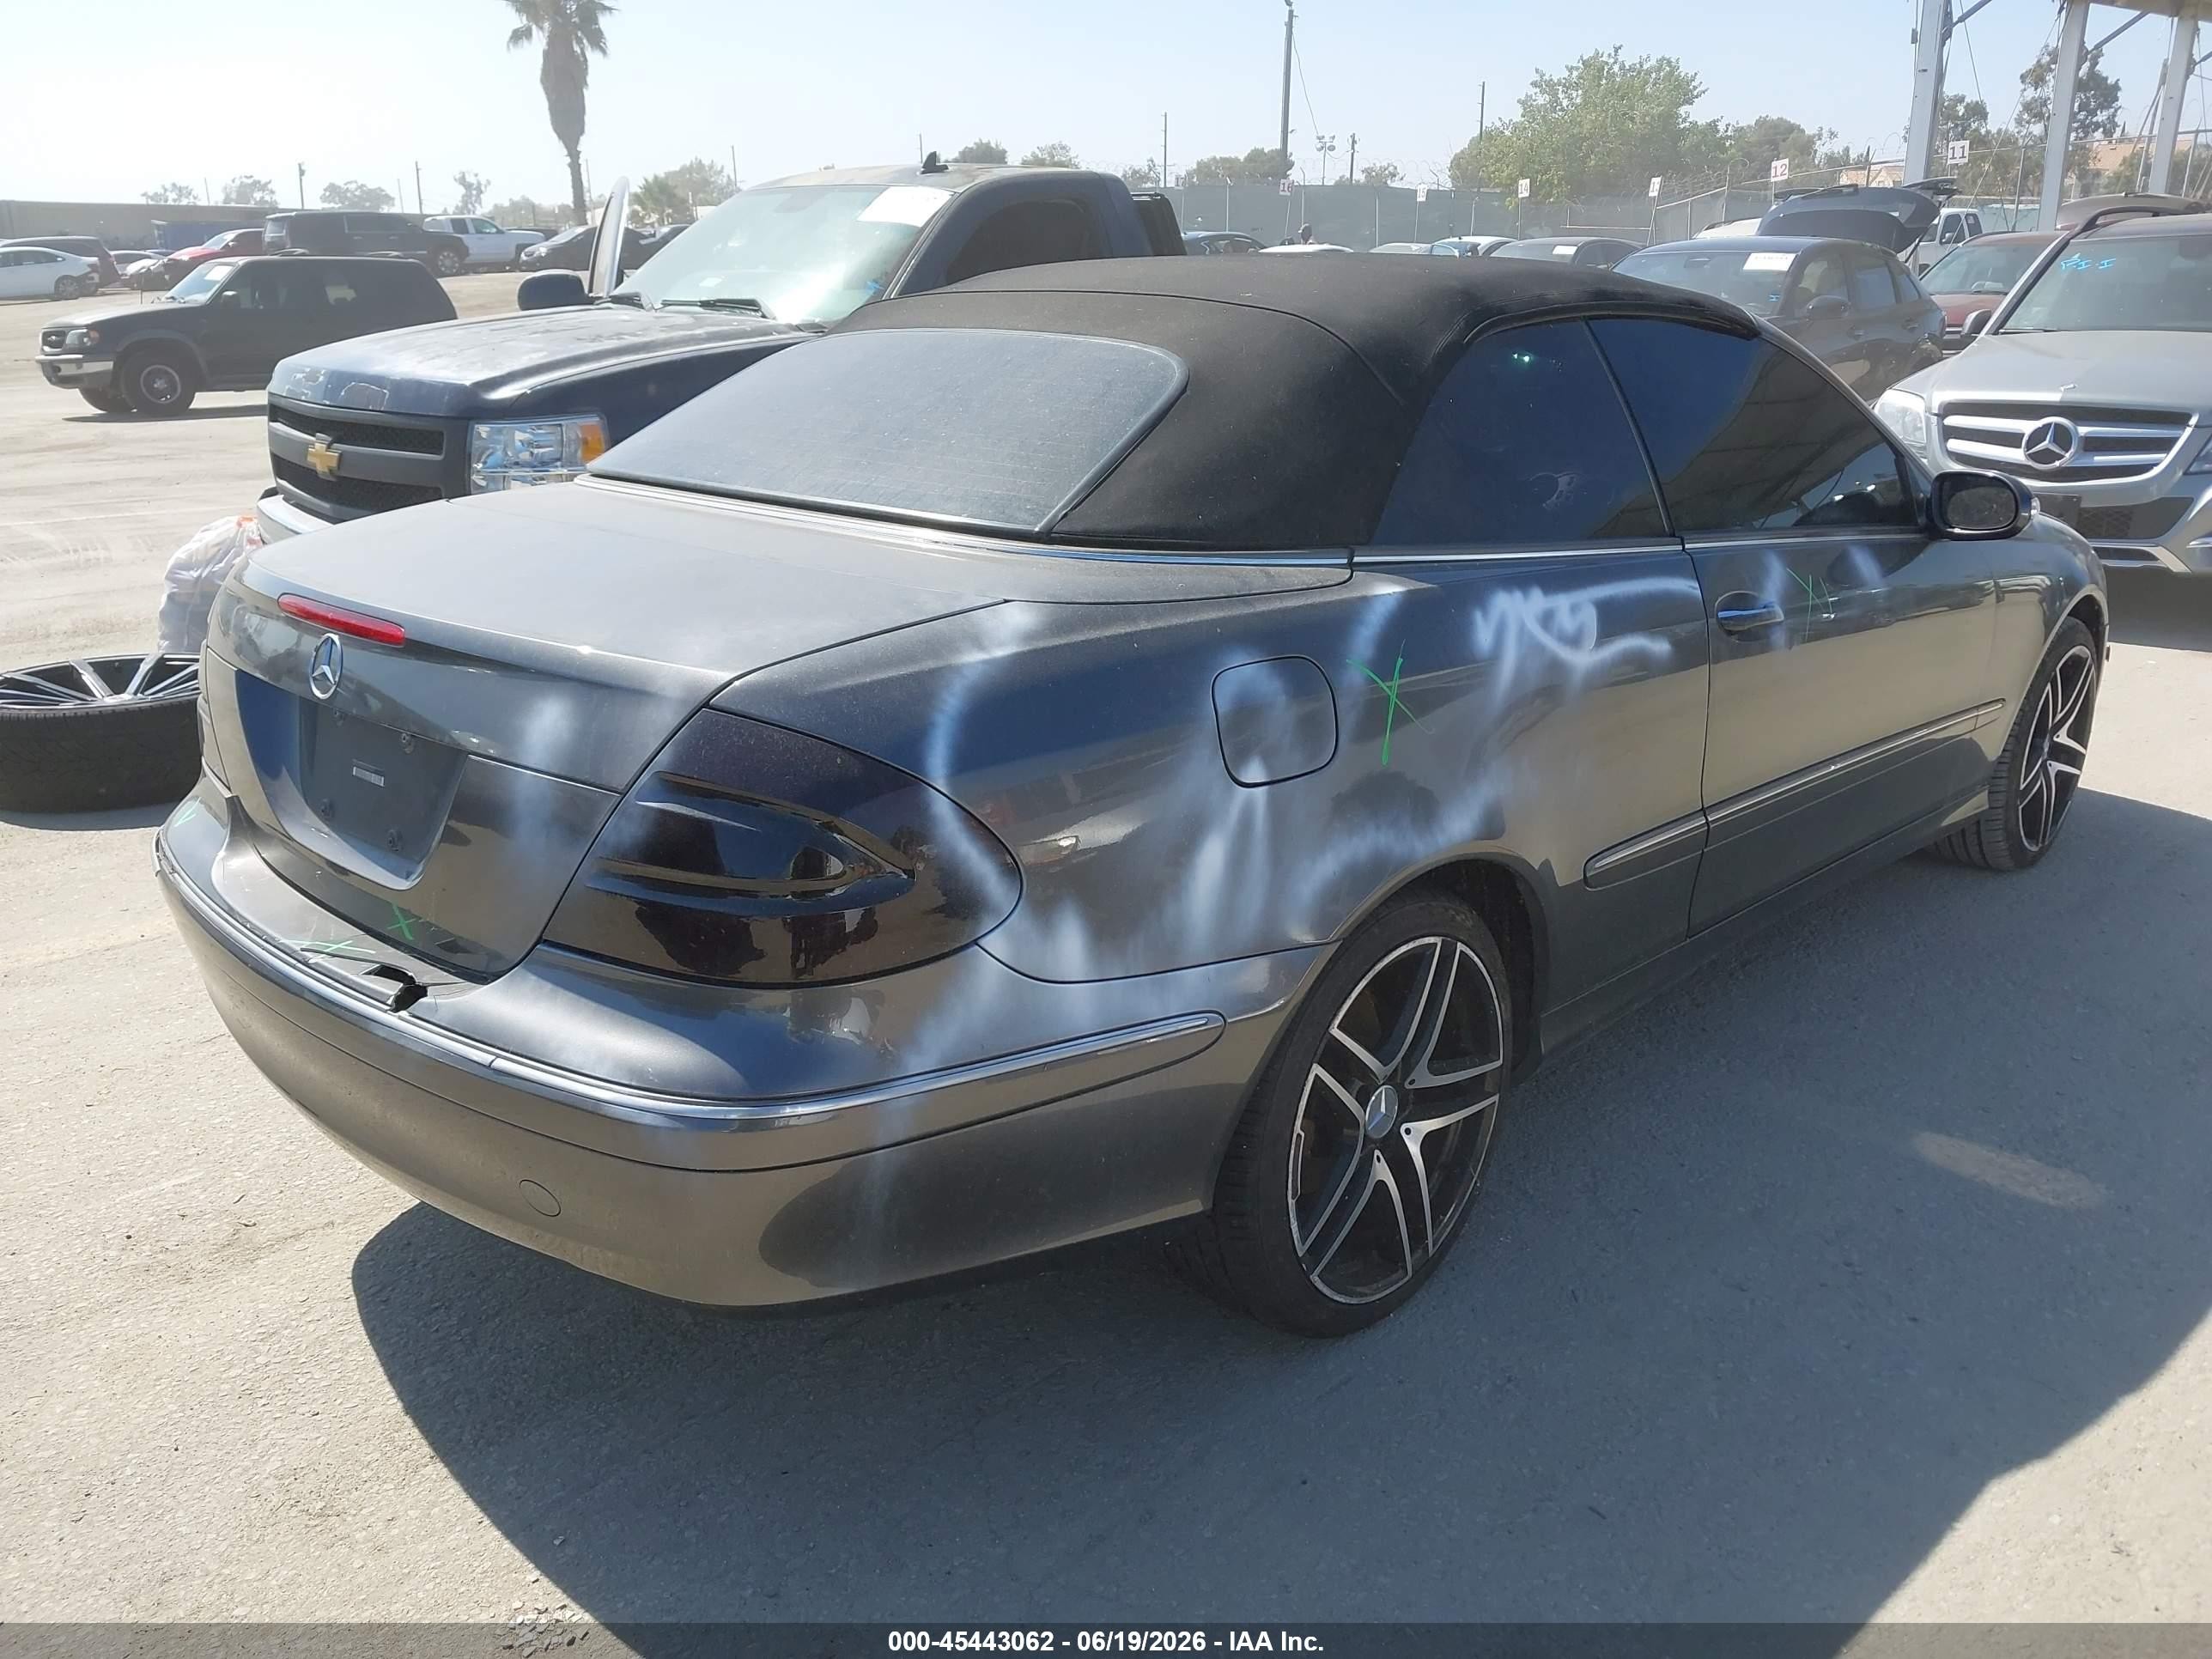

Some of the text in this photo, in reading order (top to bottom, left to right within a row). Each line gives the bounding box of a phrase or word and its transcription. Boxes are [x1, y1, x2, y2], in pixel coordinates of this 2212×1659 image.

[1949, 144, 1966, 160] 11
[1771, 163, 1787, 178] 12
[1280, 182, 1292, 193] 16
[1418, 187, 1426, 198] 15
[1519, 182, 1528, 194] 14
